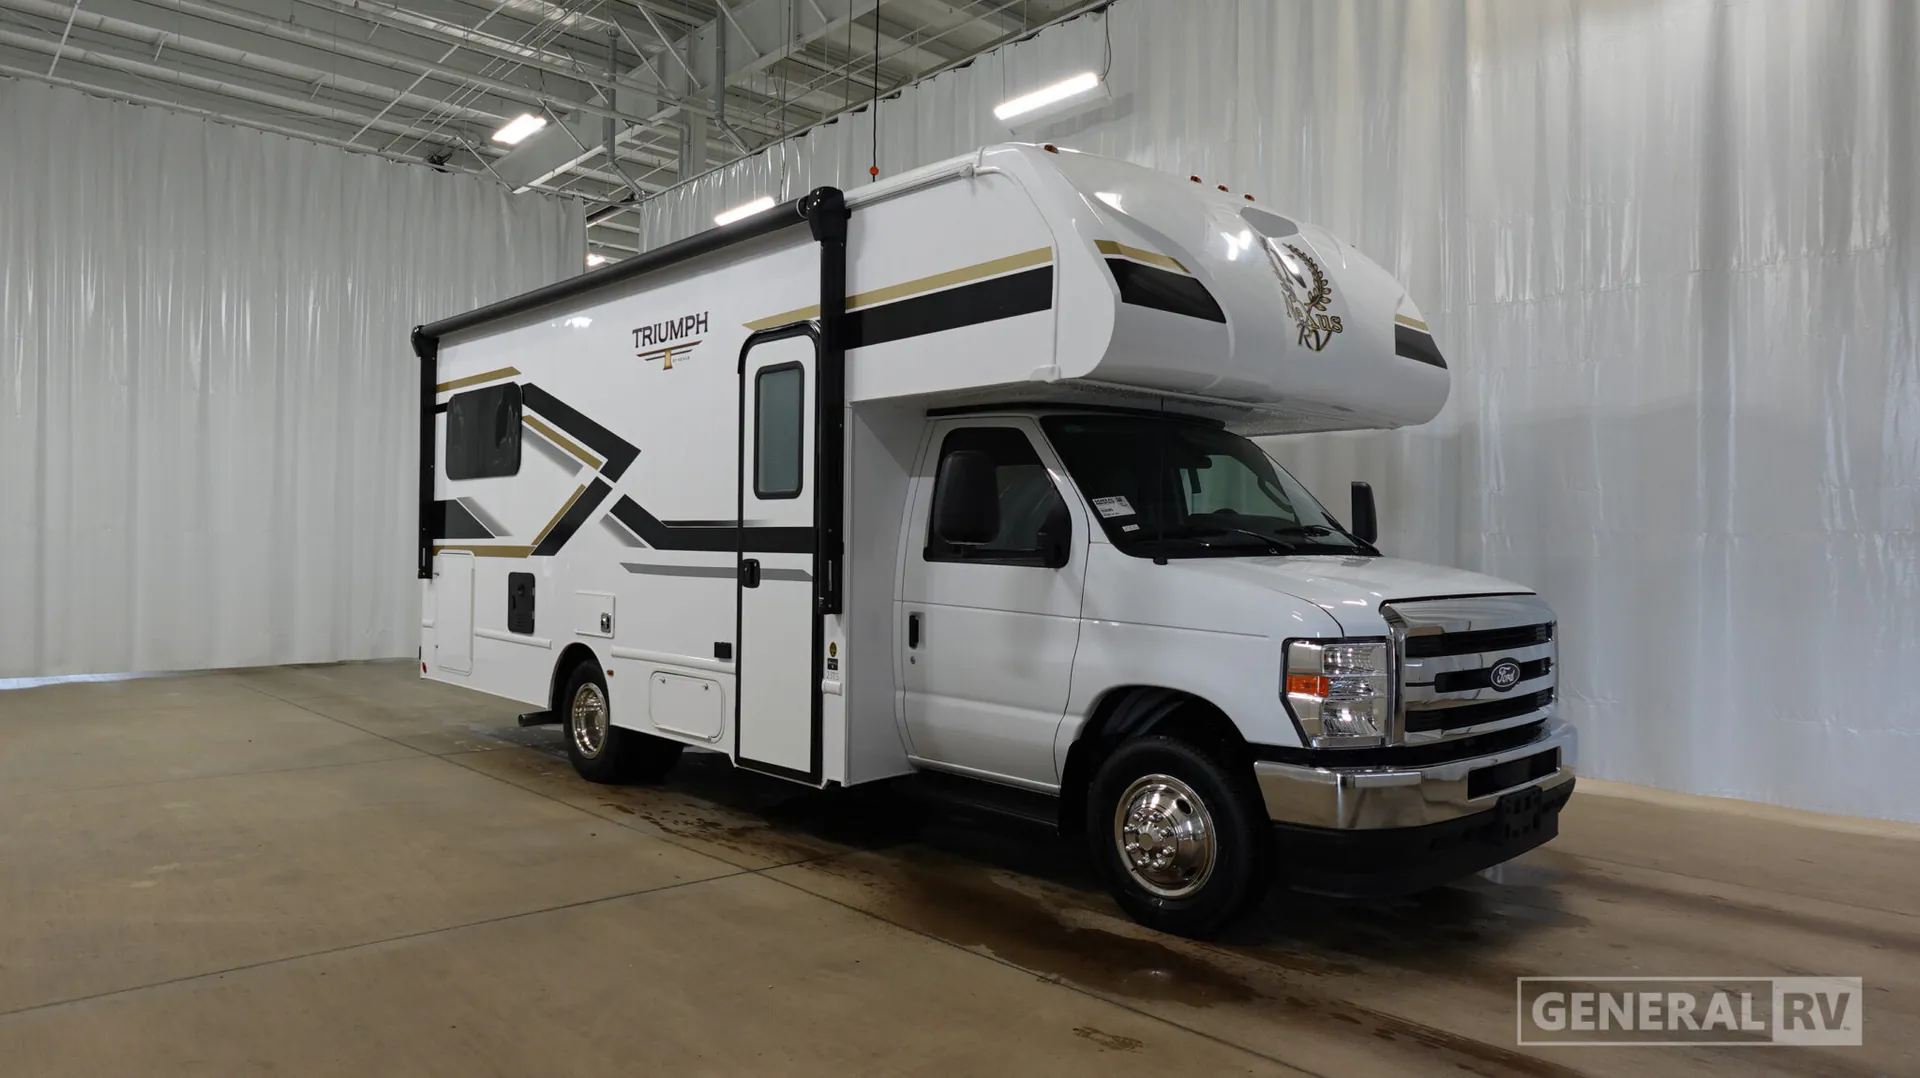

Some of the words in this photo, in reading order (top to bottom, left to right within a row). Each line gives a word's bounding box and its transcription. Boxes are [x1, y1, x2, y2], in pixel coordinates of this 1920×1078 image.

[632, 311, 709, 348] TRIUMPH
[1298, 323, 1332, 352] RV
[1496, 666, 1515, 684] Ford
